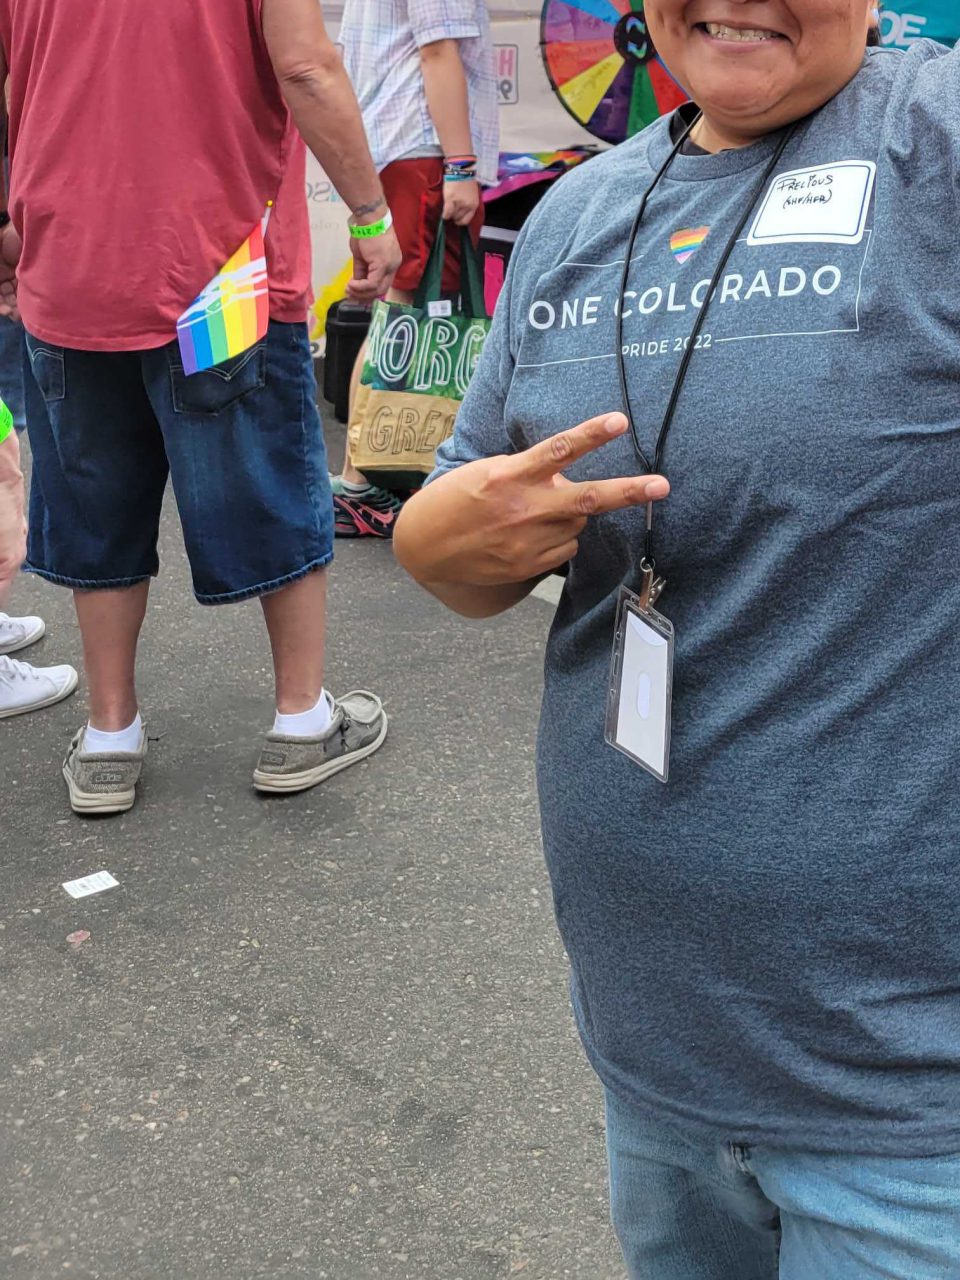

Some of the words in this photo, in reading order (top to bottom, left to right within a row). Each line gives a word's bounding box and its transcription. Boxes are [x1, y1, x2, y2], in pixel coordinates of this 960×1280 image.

[528, 295, 602, 330] ONE
[613, 265, 841, 320] COLORADO
[622, 339, 669, 358] PRIDE
